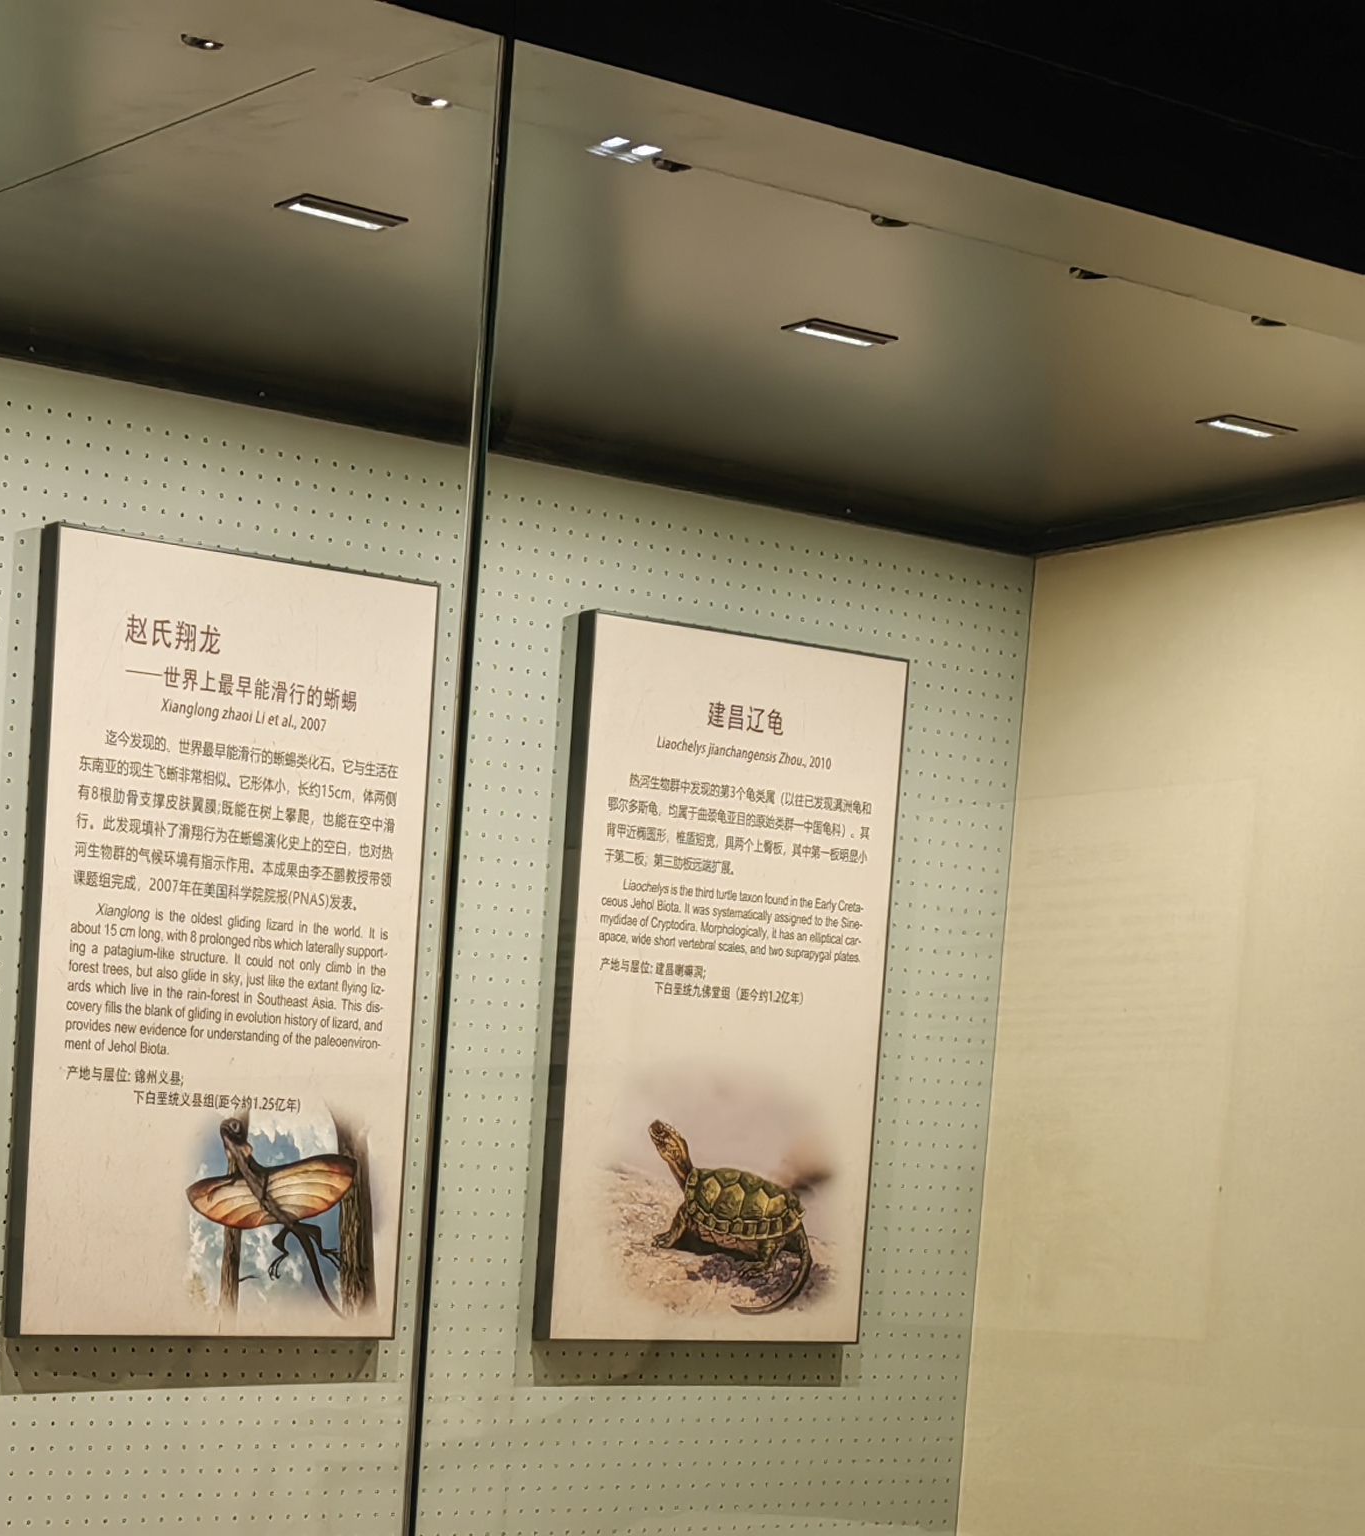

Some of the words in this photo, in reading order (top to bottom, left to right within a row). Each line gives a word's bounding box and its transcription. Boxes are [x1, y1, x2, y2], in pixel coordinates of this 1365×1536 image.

[160, 697, 220, 722] Xianglong
[221, 705, 253, 723] zhaoi
[255, 710, 266, 725] Li
[267, 714, 280, 727] et
[299, 715, 327, 732] 2007
[683, 902, 691, 915] It
[95, 902, 151, 923] Xianglong
[154, 908, 164, 922] is
[169, 909, 186, 923] the
[190, 911, 223, 927] oldest
[227, 914, 262, 933] gliding
[266, 917, 294, 933] lizard
[298, 920, 309, 934] in
[312, 922, 329, 936] the
[368, 926, 376, 940] It
[379, 927, 389, 941] is
[64, 1038, 92, 1051] ment
[93, 1038, 106, 1052] of
[107, 1038, 137, 1054] Jehol
